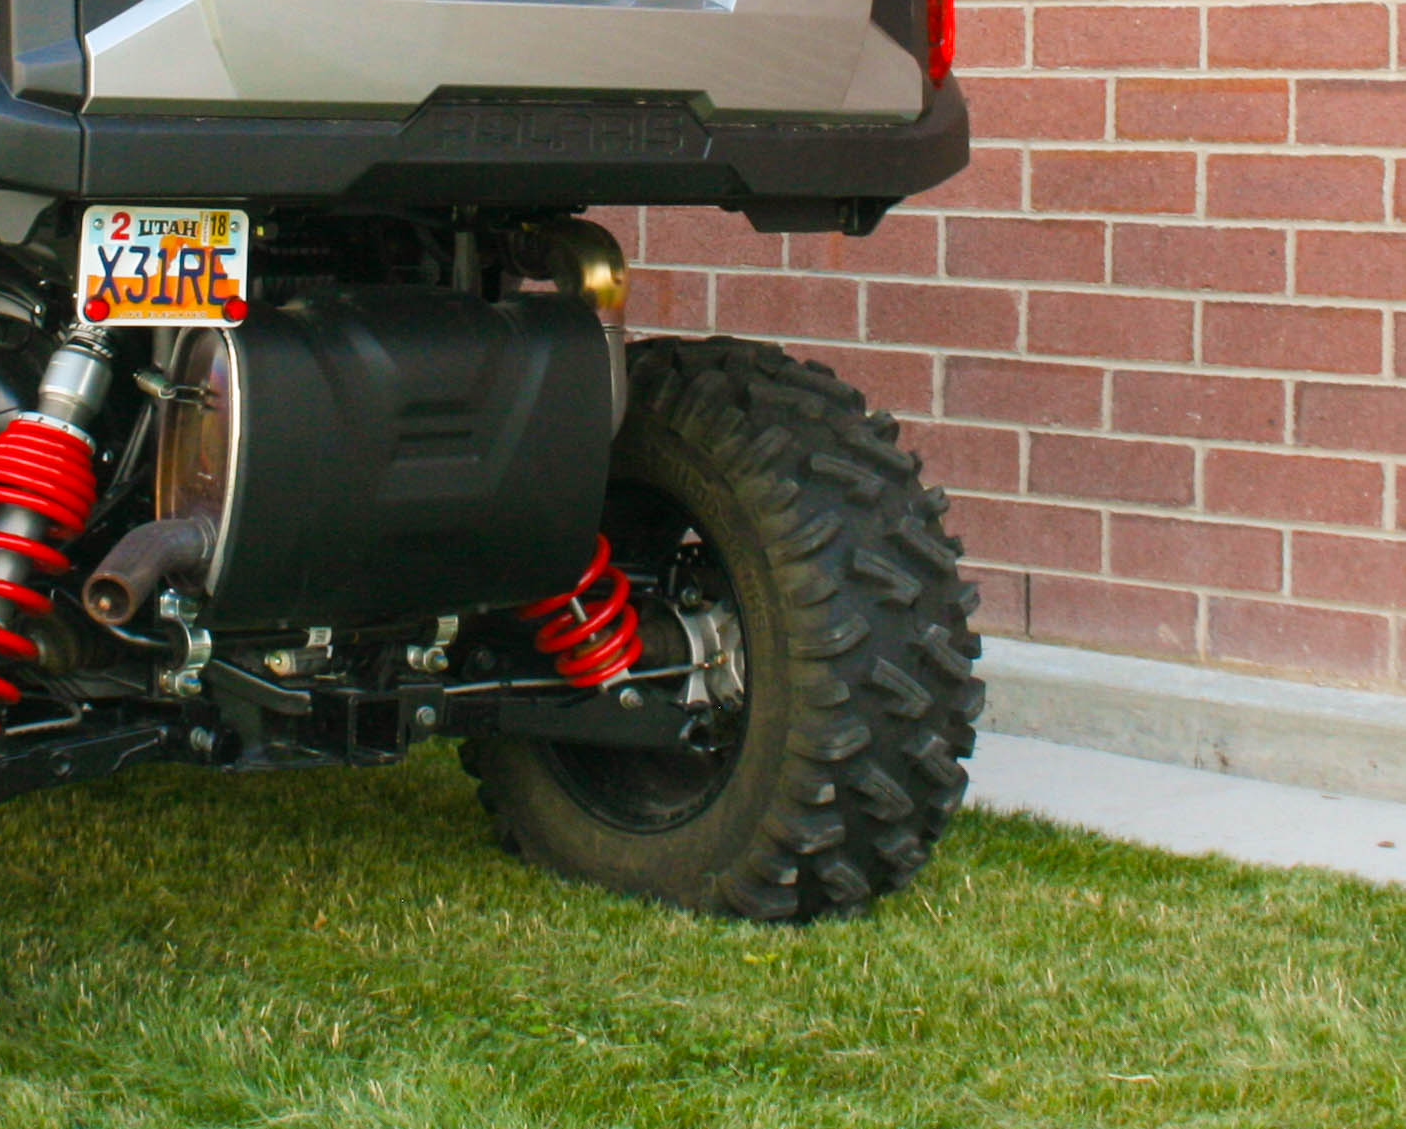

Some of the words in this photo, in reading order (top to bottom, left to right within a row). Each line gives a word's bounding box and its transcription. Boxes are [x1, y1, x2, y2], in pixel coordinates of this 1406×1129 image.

[110, 211, 132, 241] 2
[137, 218, 200, 239] UTAH
[209, 213, 227, 237] 18
[96, 244, 238, 306] X31RE
